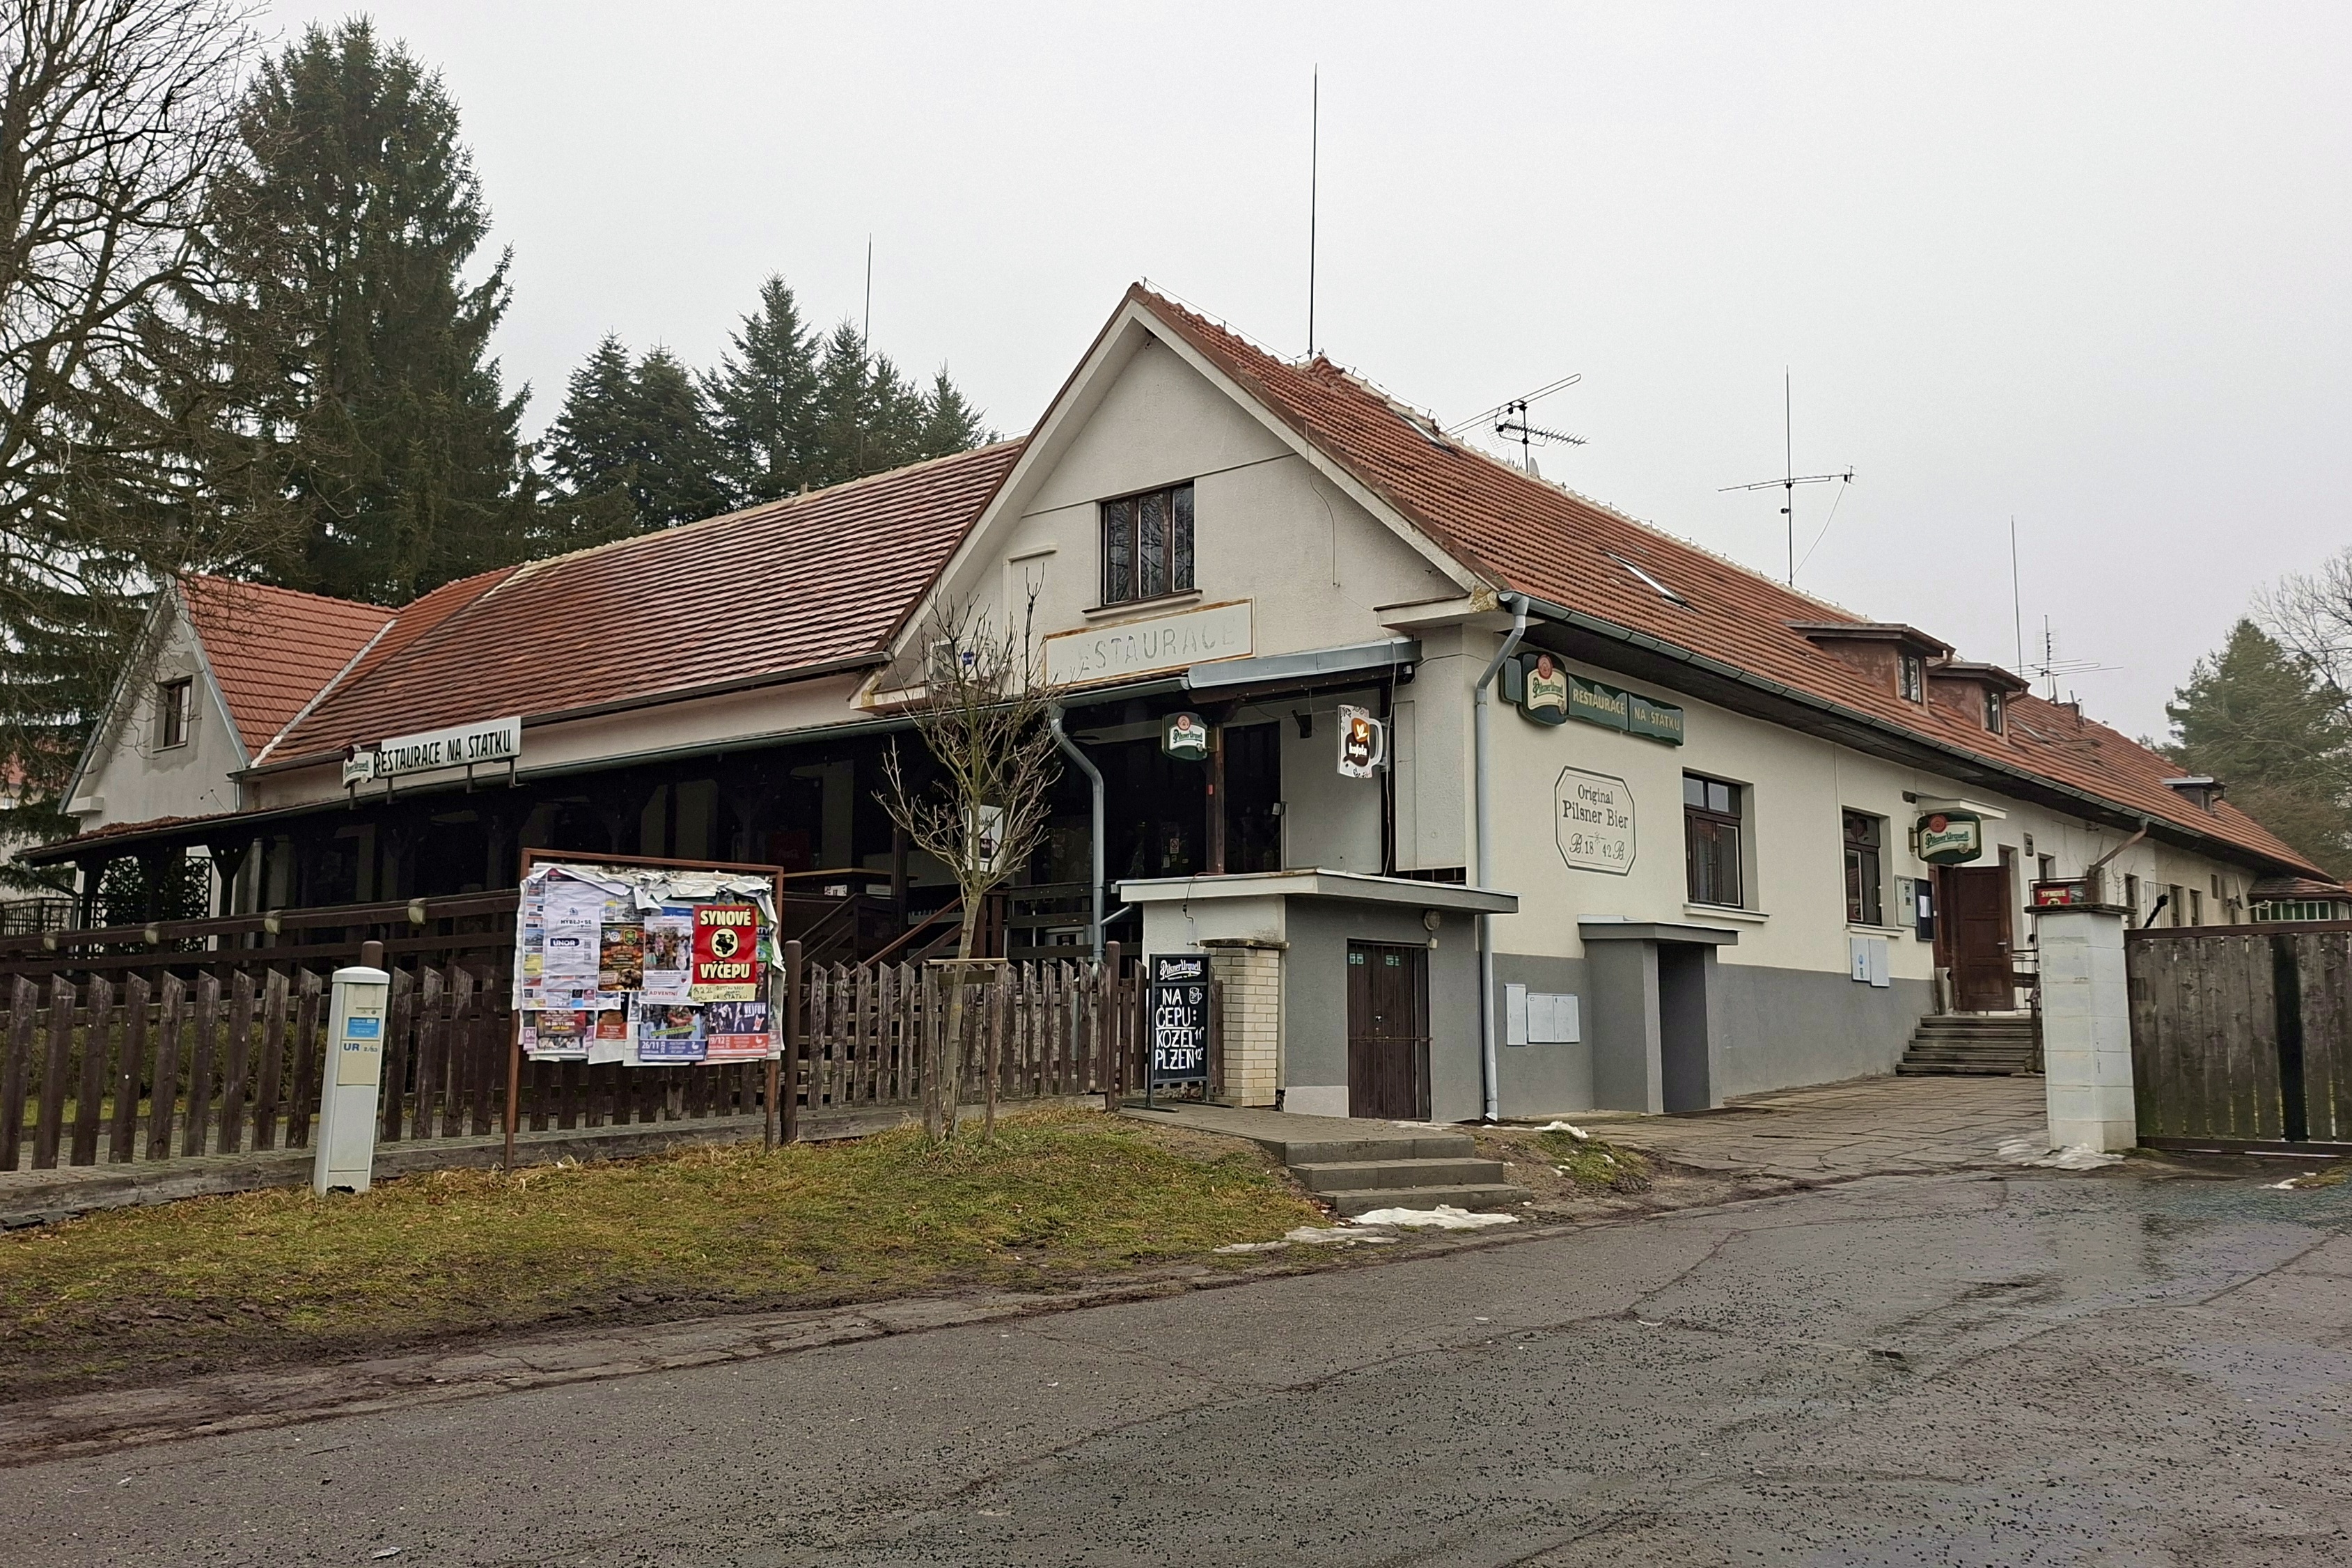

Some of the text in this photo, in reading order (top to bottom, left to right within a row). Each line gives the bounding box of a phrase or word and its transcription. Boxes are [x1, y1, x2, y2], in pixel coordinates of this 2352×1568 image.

[1573, 688, 1680, 730] RESTAURACE NA STATKU
[374, 729, 511, 776] RESTAURACE NA STATKU
[1349, 742, 1367, 757] kofola
[1578, 784, 1613, 805] Original
[1562, 800, 1628, 829] Pilsner Bier
[700, 909, 751, 926] SYNOVÉ
[700, 960, 751, 979] VÝČEPU
[1160, 959, 1202, 980] Pilsner Urquell
[1162, 988, 1182, 1005] NA
[343, 1043, 359, 1051] UR
[642, 1041, 659, 1049] 26/11
[709, 1036, 725, 1044] 19/12
[1157, 1030, 1196, 1048] KOZEL
